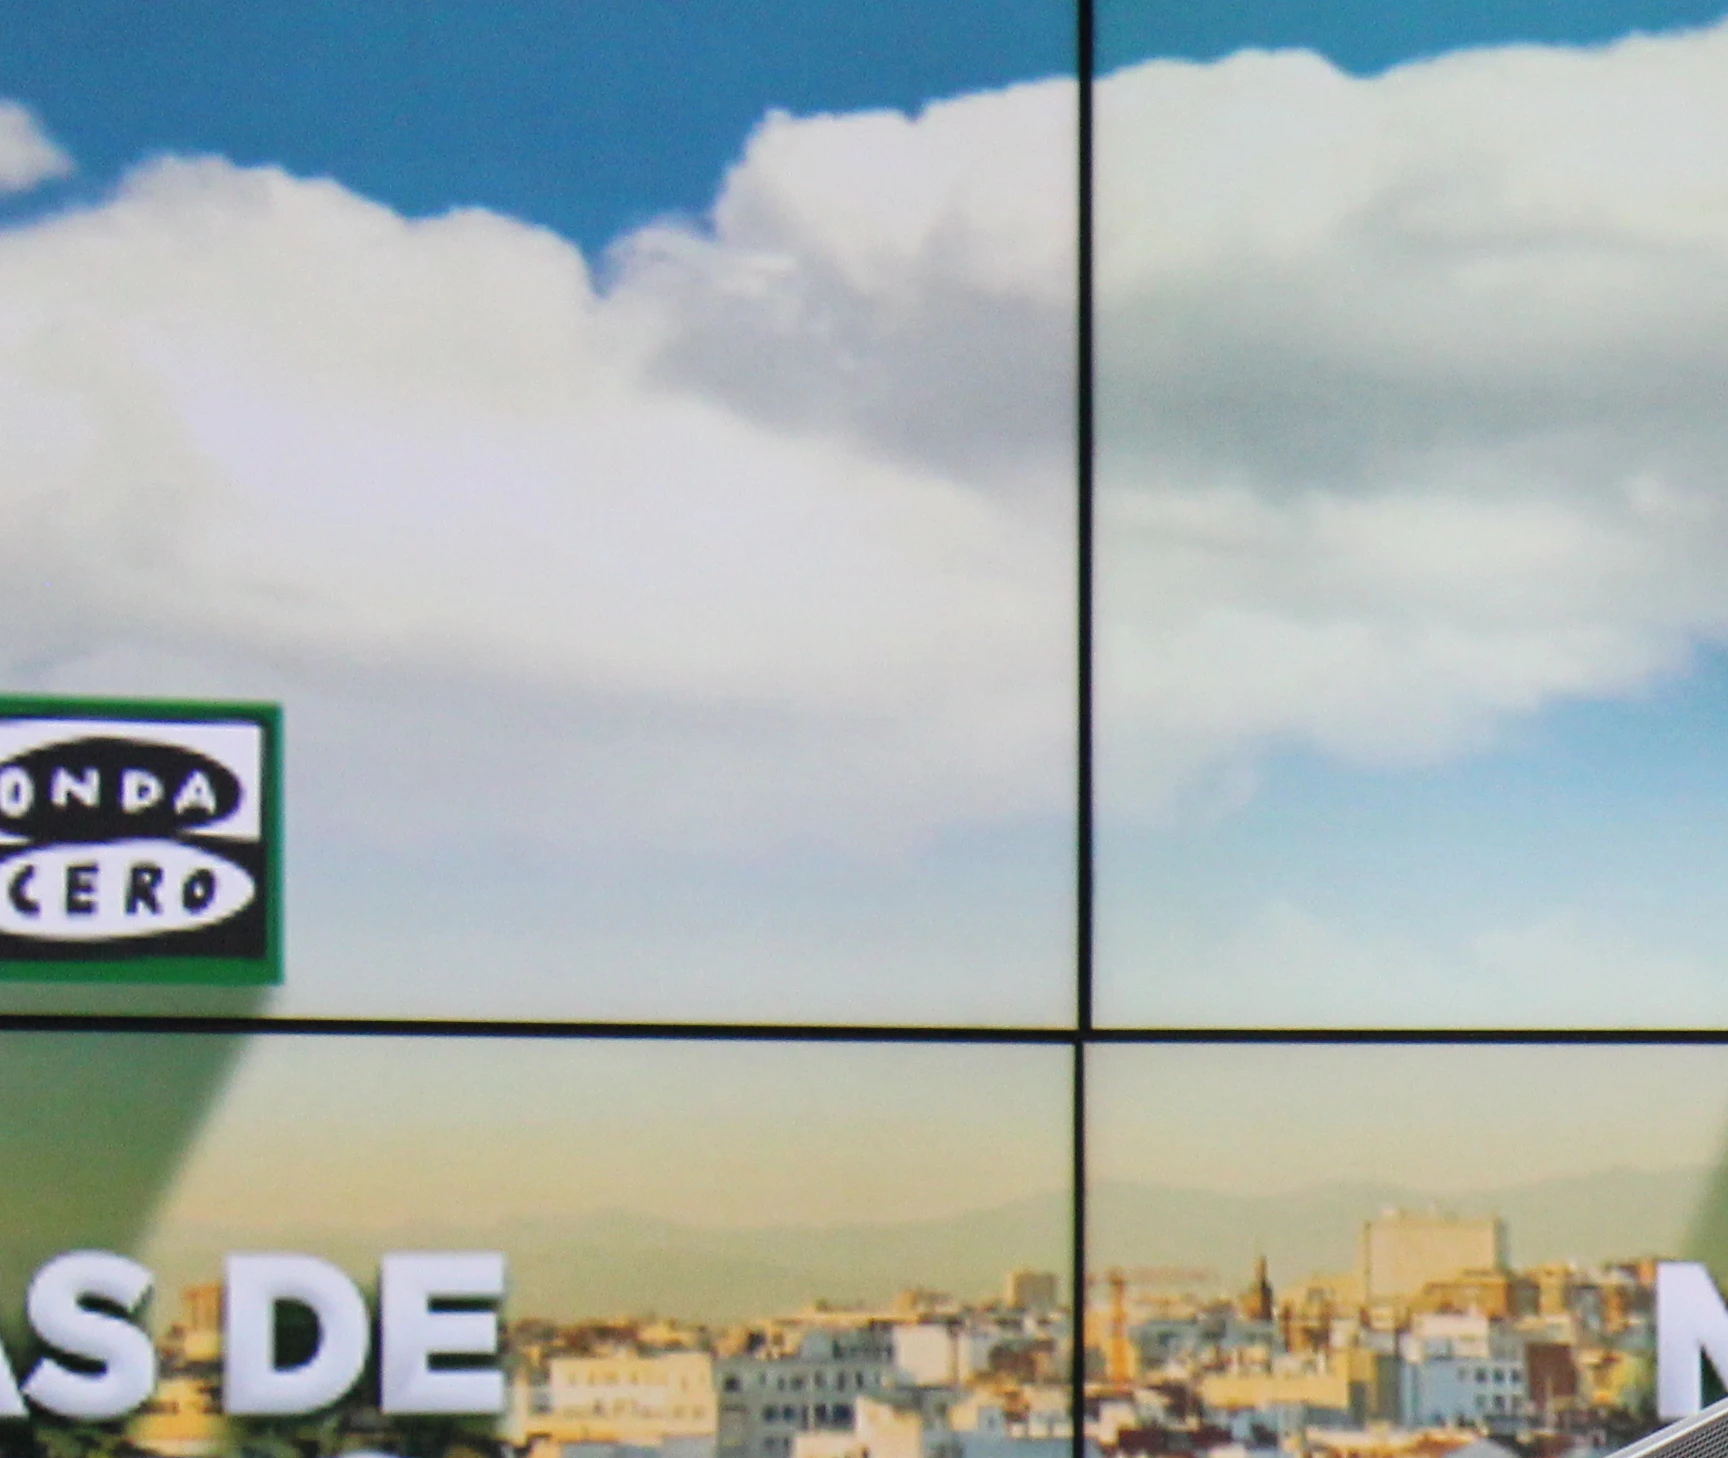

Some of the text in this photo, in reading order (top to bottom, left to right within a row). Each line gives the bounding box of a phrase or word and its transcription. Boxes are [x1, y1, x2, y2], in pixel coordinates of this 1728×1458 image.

[0, 766, 217, 818] ONDA
[8, 862, 218, 918] CERO
[222, 1250, 507, 1415] DE
